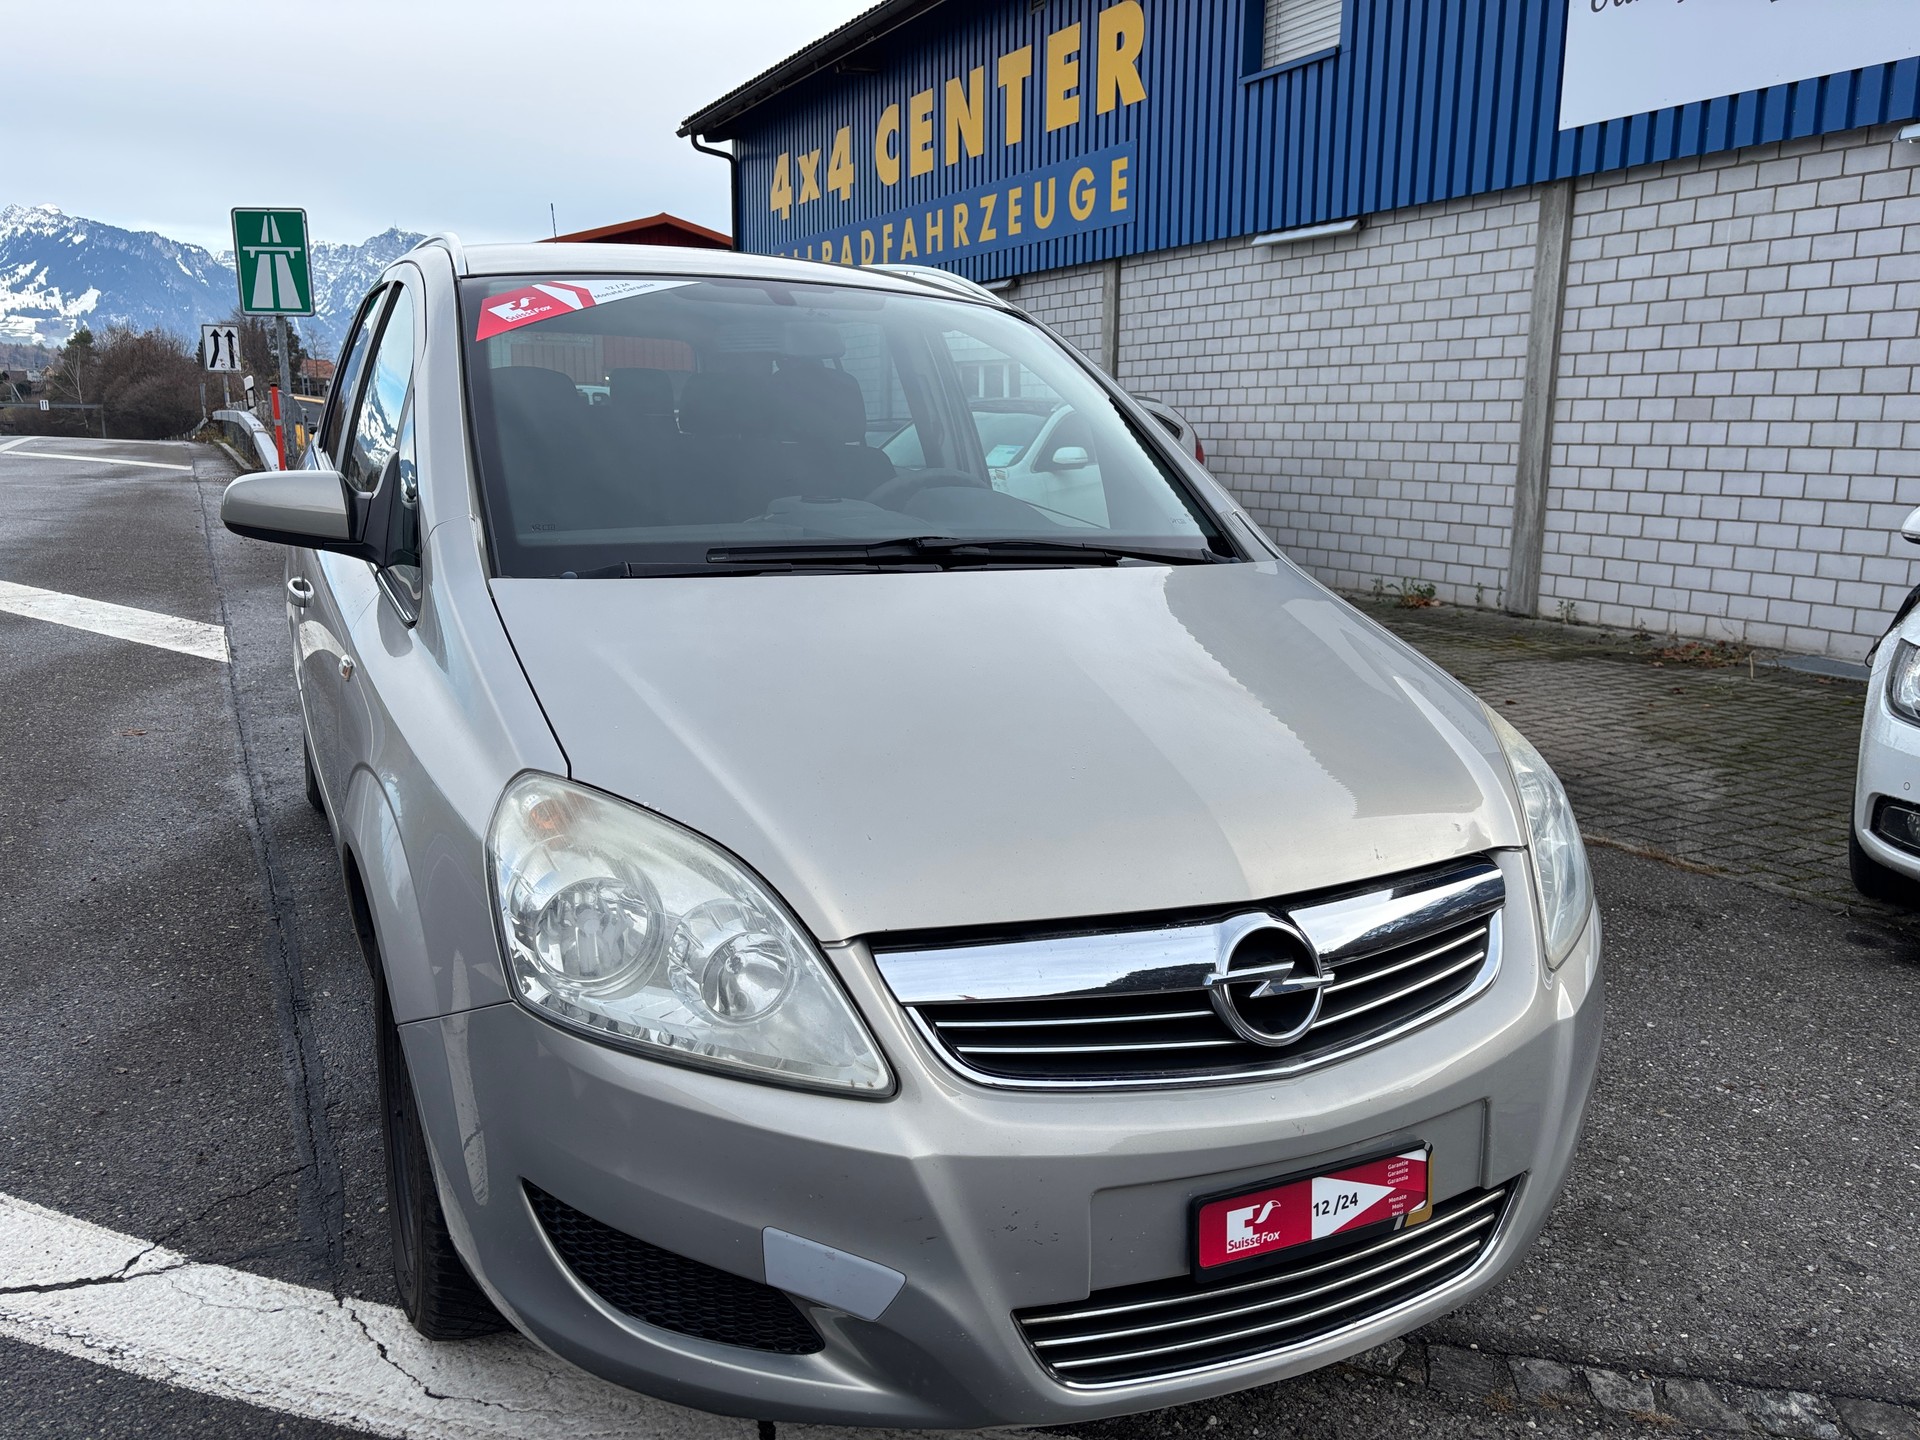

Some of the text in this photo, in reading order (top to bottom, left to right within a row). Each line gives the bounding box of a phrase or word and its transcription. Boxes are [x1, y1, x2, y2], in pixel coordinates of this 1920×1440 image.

[875, 0, 1148, 187] CENTER
[778, 156, 1129, 266] RADFAHRZEUGE
[593, 282, 655, 299] Monate Garantie
[1387, 1160, 1409, 1170] Garantie
[1387, 1168, 1409, 1178] Garantie
[1387, 1175, 1409, 1185] Garanzia
[1388, 1194, 1407, 1204] Monate
[1391, 1202, 1404, 1210] Mois
[1228, 1230, 1280, 1252] SuisseFox
